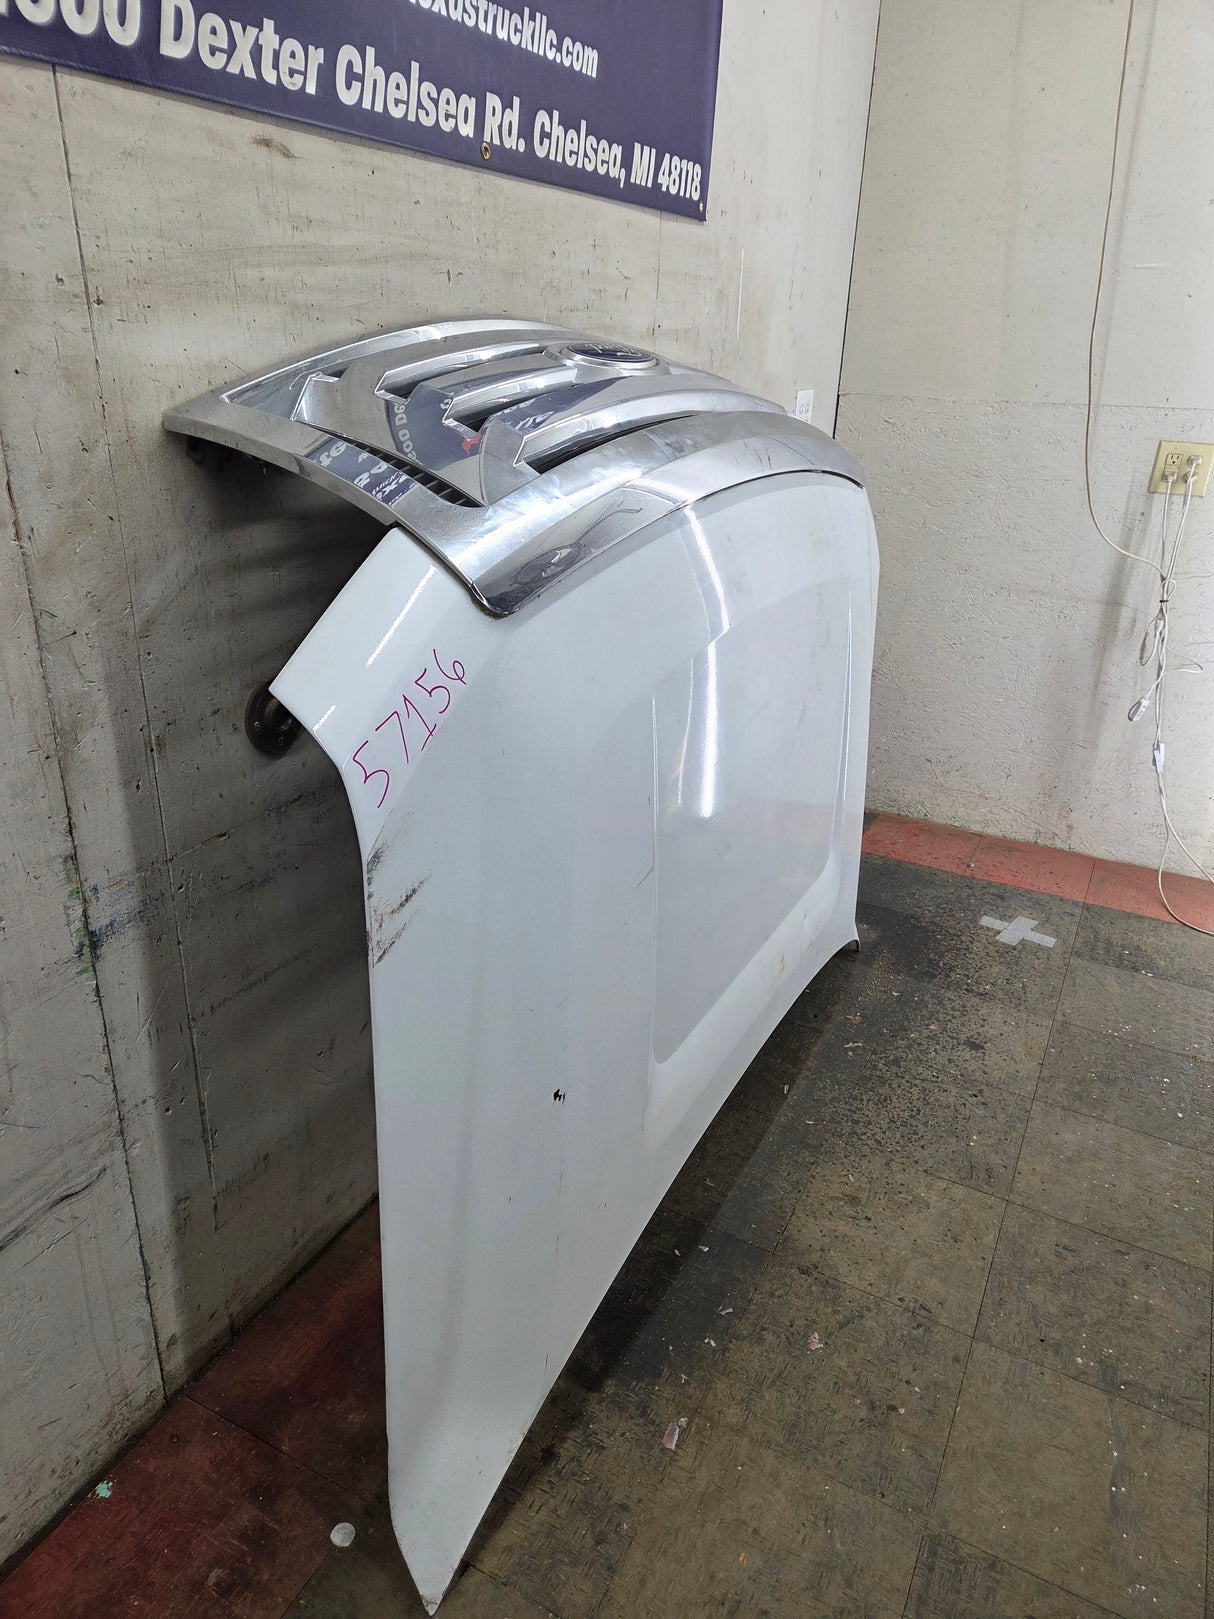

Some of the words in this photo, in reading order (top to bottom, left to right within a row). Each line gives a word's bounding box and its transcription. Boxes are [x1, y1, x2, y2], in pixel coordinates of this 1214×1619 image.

[160, 0, 325, 95] Dexter
[336, 44, 476, 139] Chelsea
[483, 91, 526, 153] Rd.
[533, 110, 626, 188] Chelsea,
[630, 142, 657, 187] MI
[657, 153, 702, 200] 48118
[408, 0, 599, 78] astruckllc.com
[352, 648, 467, 808] 57156
